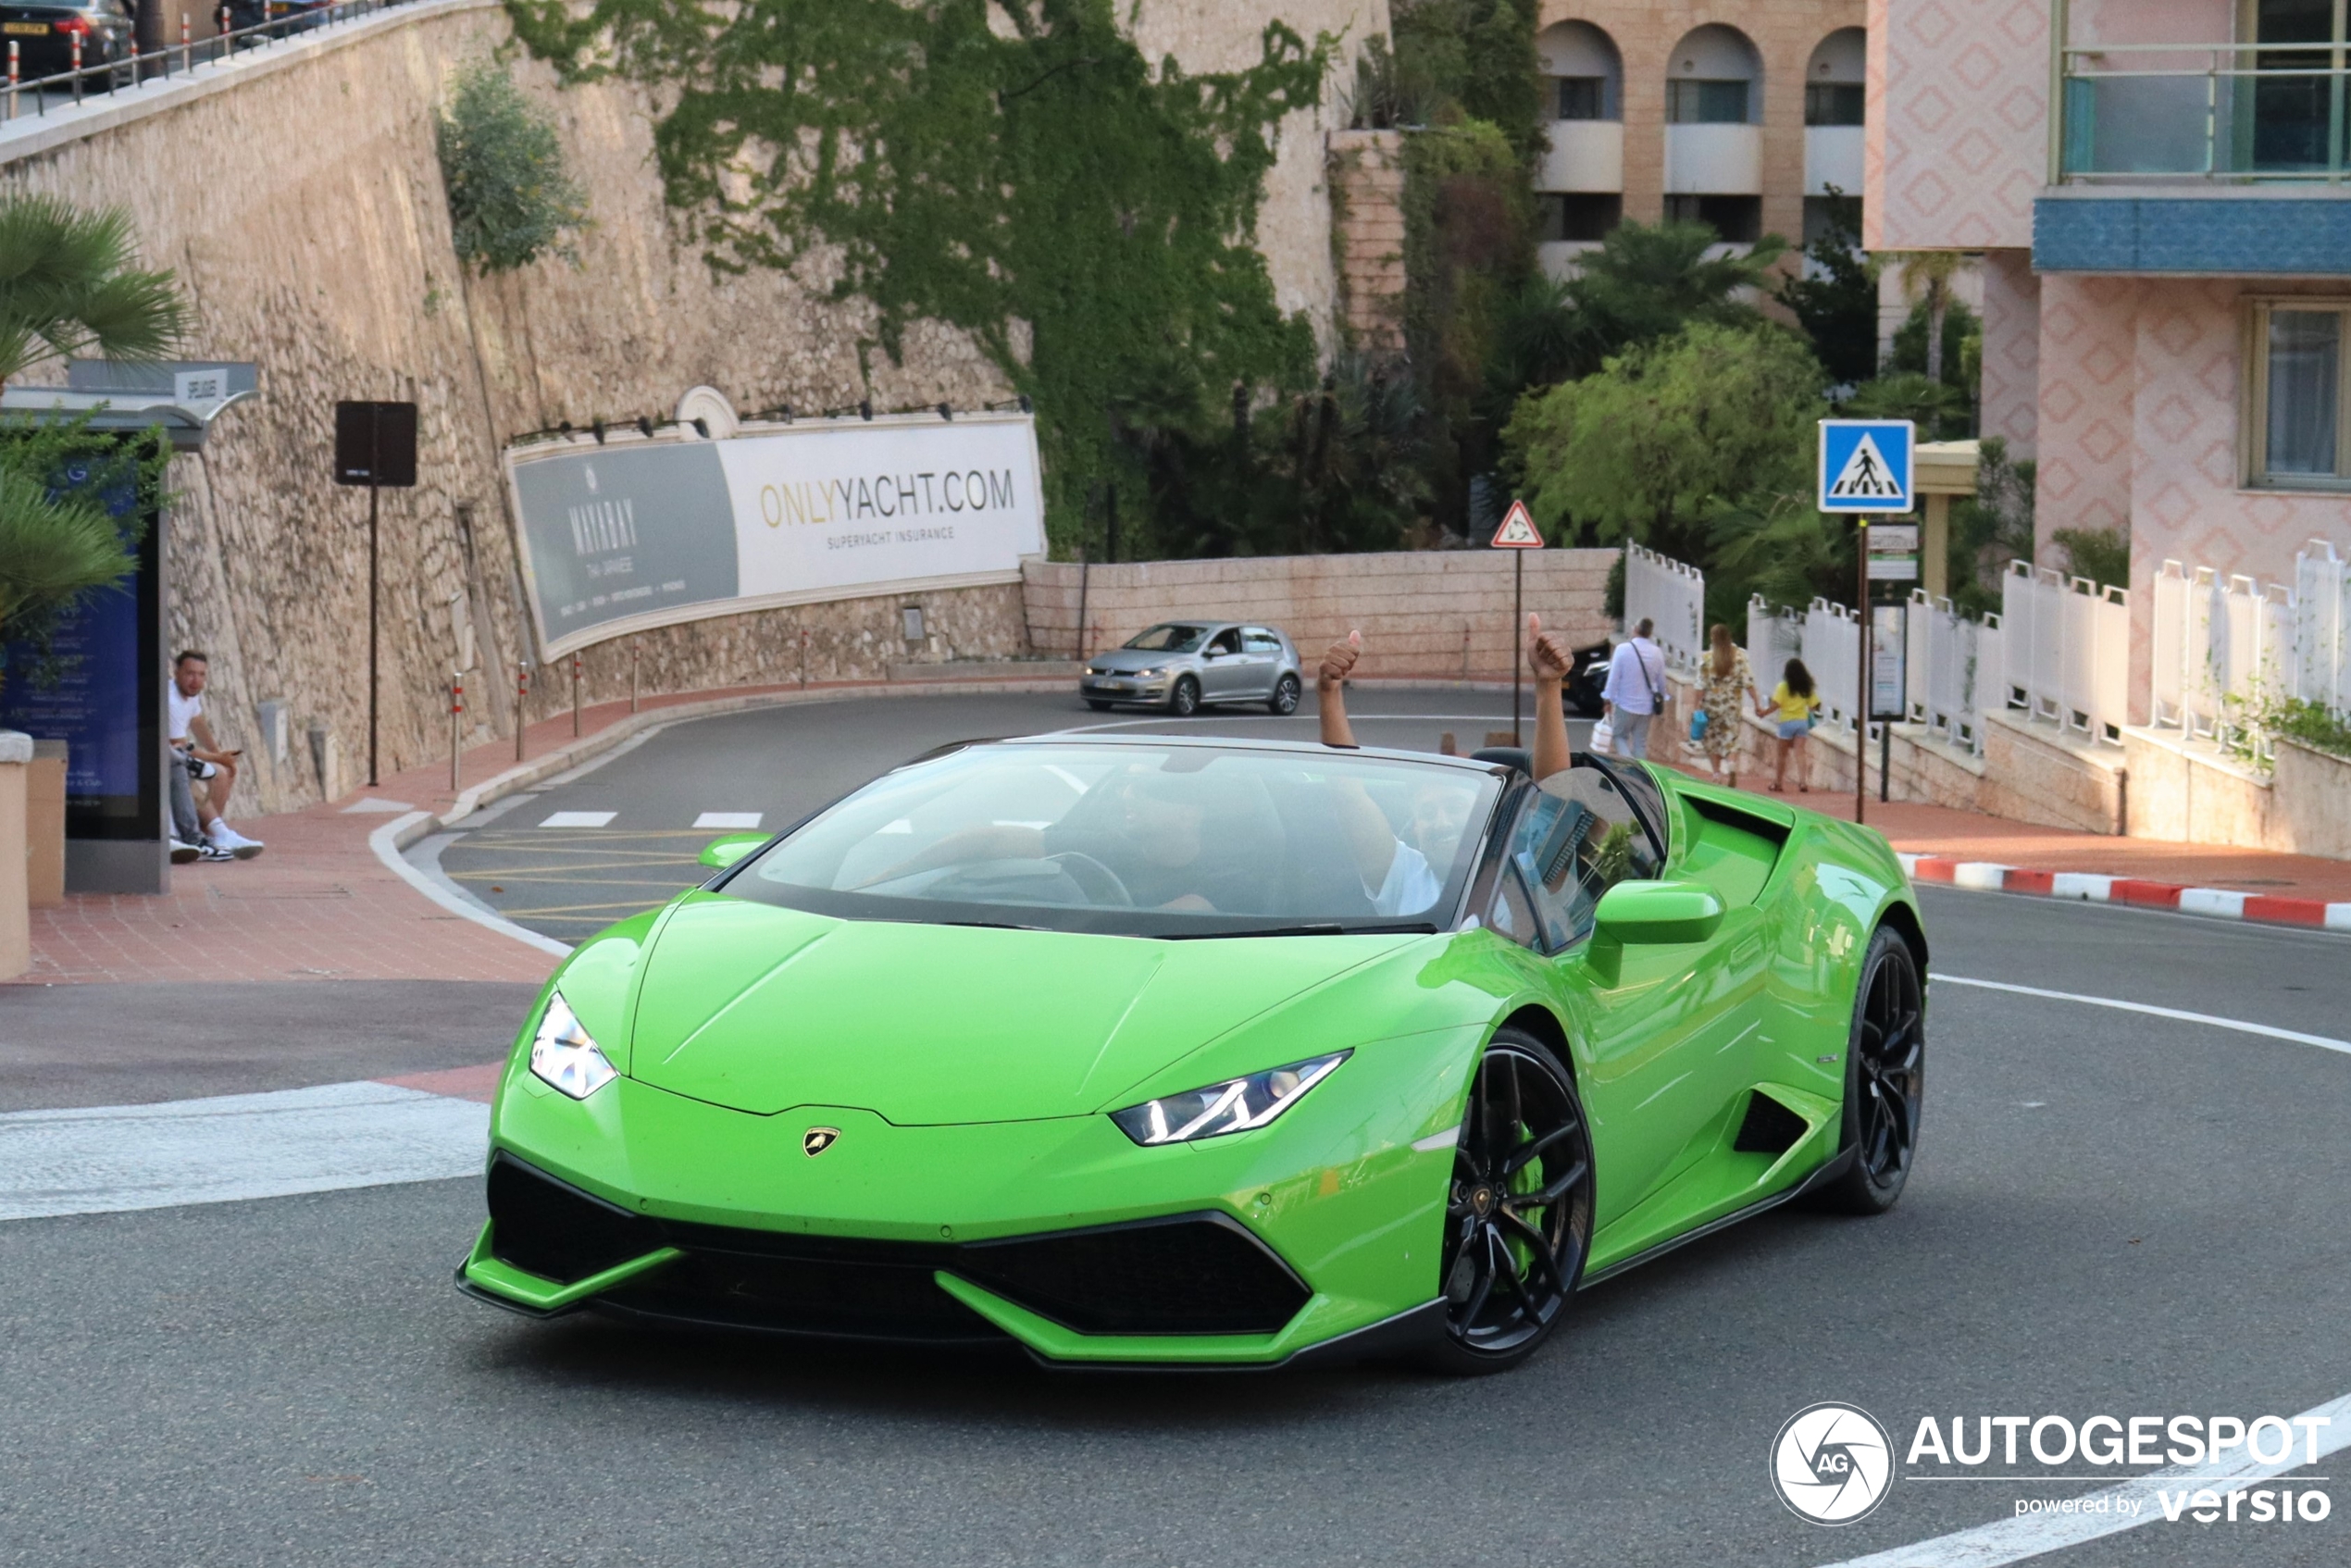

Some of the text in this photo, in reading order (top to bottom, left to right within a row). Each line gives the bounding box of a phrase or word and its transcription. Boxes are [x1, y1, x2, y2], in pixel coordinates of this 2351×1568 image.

[760, 469, 1014, 529] ONLYYACHT.COM
[827, 526, 954, 550] SUPERYACHT INSURANCE
